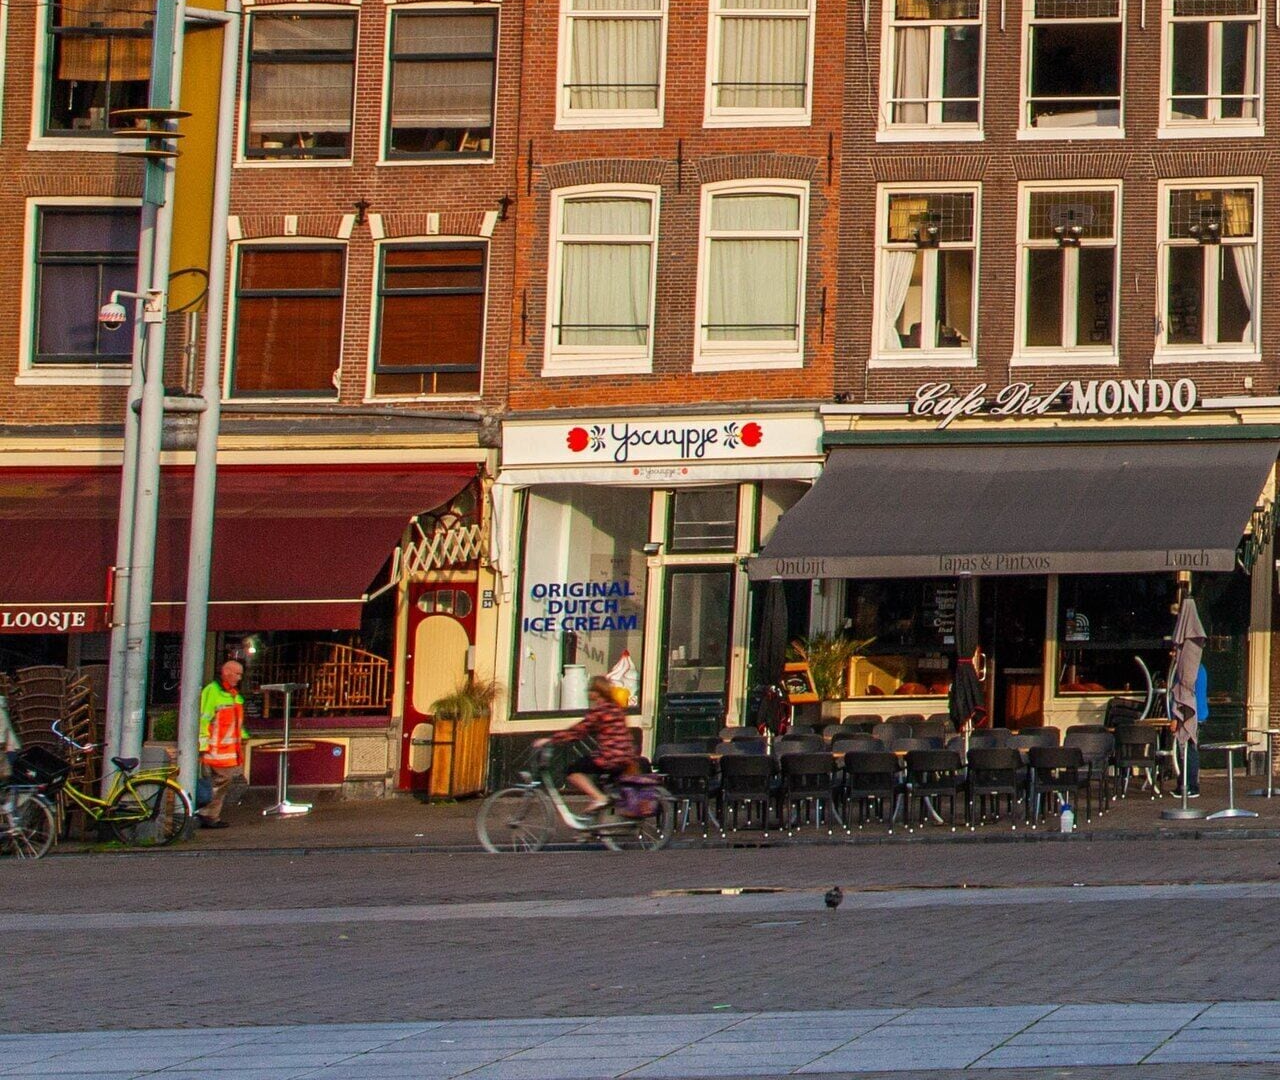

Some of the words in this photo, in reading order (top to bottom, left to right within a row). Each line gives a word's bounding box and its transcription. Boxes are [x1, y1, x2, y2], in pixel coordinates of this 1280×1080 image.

[913, 382, 988, 430] Cafe
[990, 381, 1069, 415] Del
[1070, 378, 1198, 415] MONDO
[611, 423, 718, 463] Yscuypje
[996, 554, 1051, 570] Pintxos
[1165, 549, 1211, 567] Lunch
[532, 580, 635, 599] ORIGINAL
[548, 599, 618, 615] DUTCH
[1, 611, 86, 632] LOOSJE
[523, 617, 556, 632] ICE
[561, 615, 638, 632] CREAM
